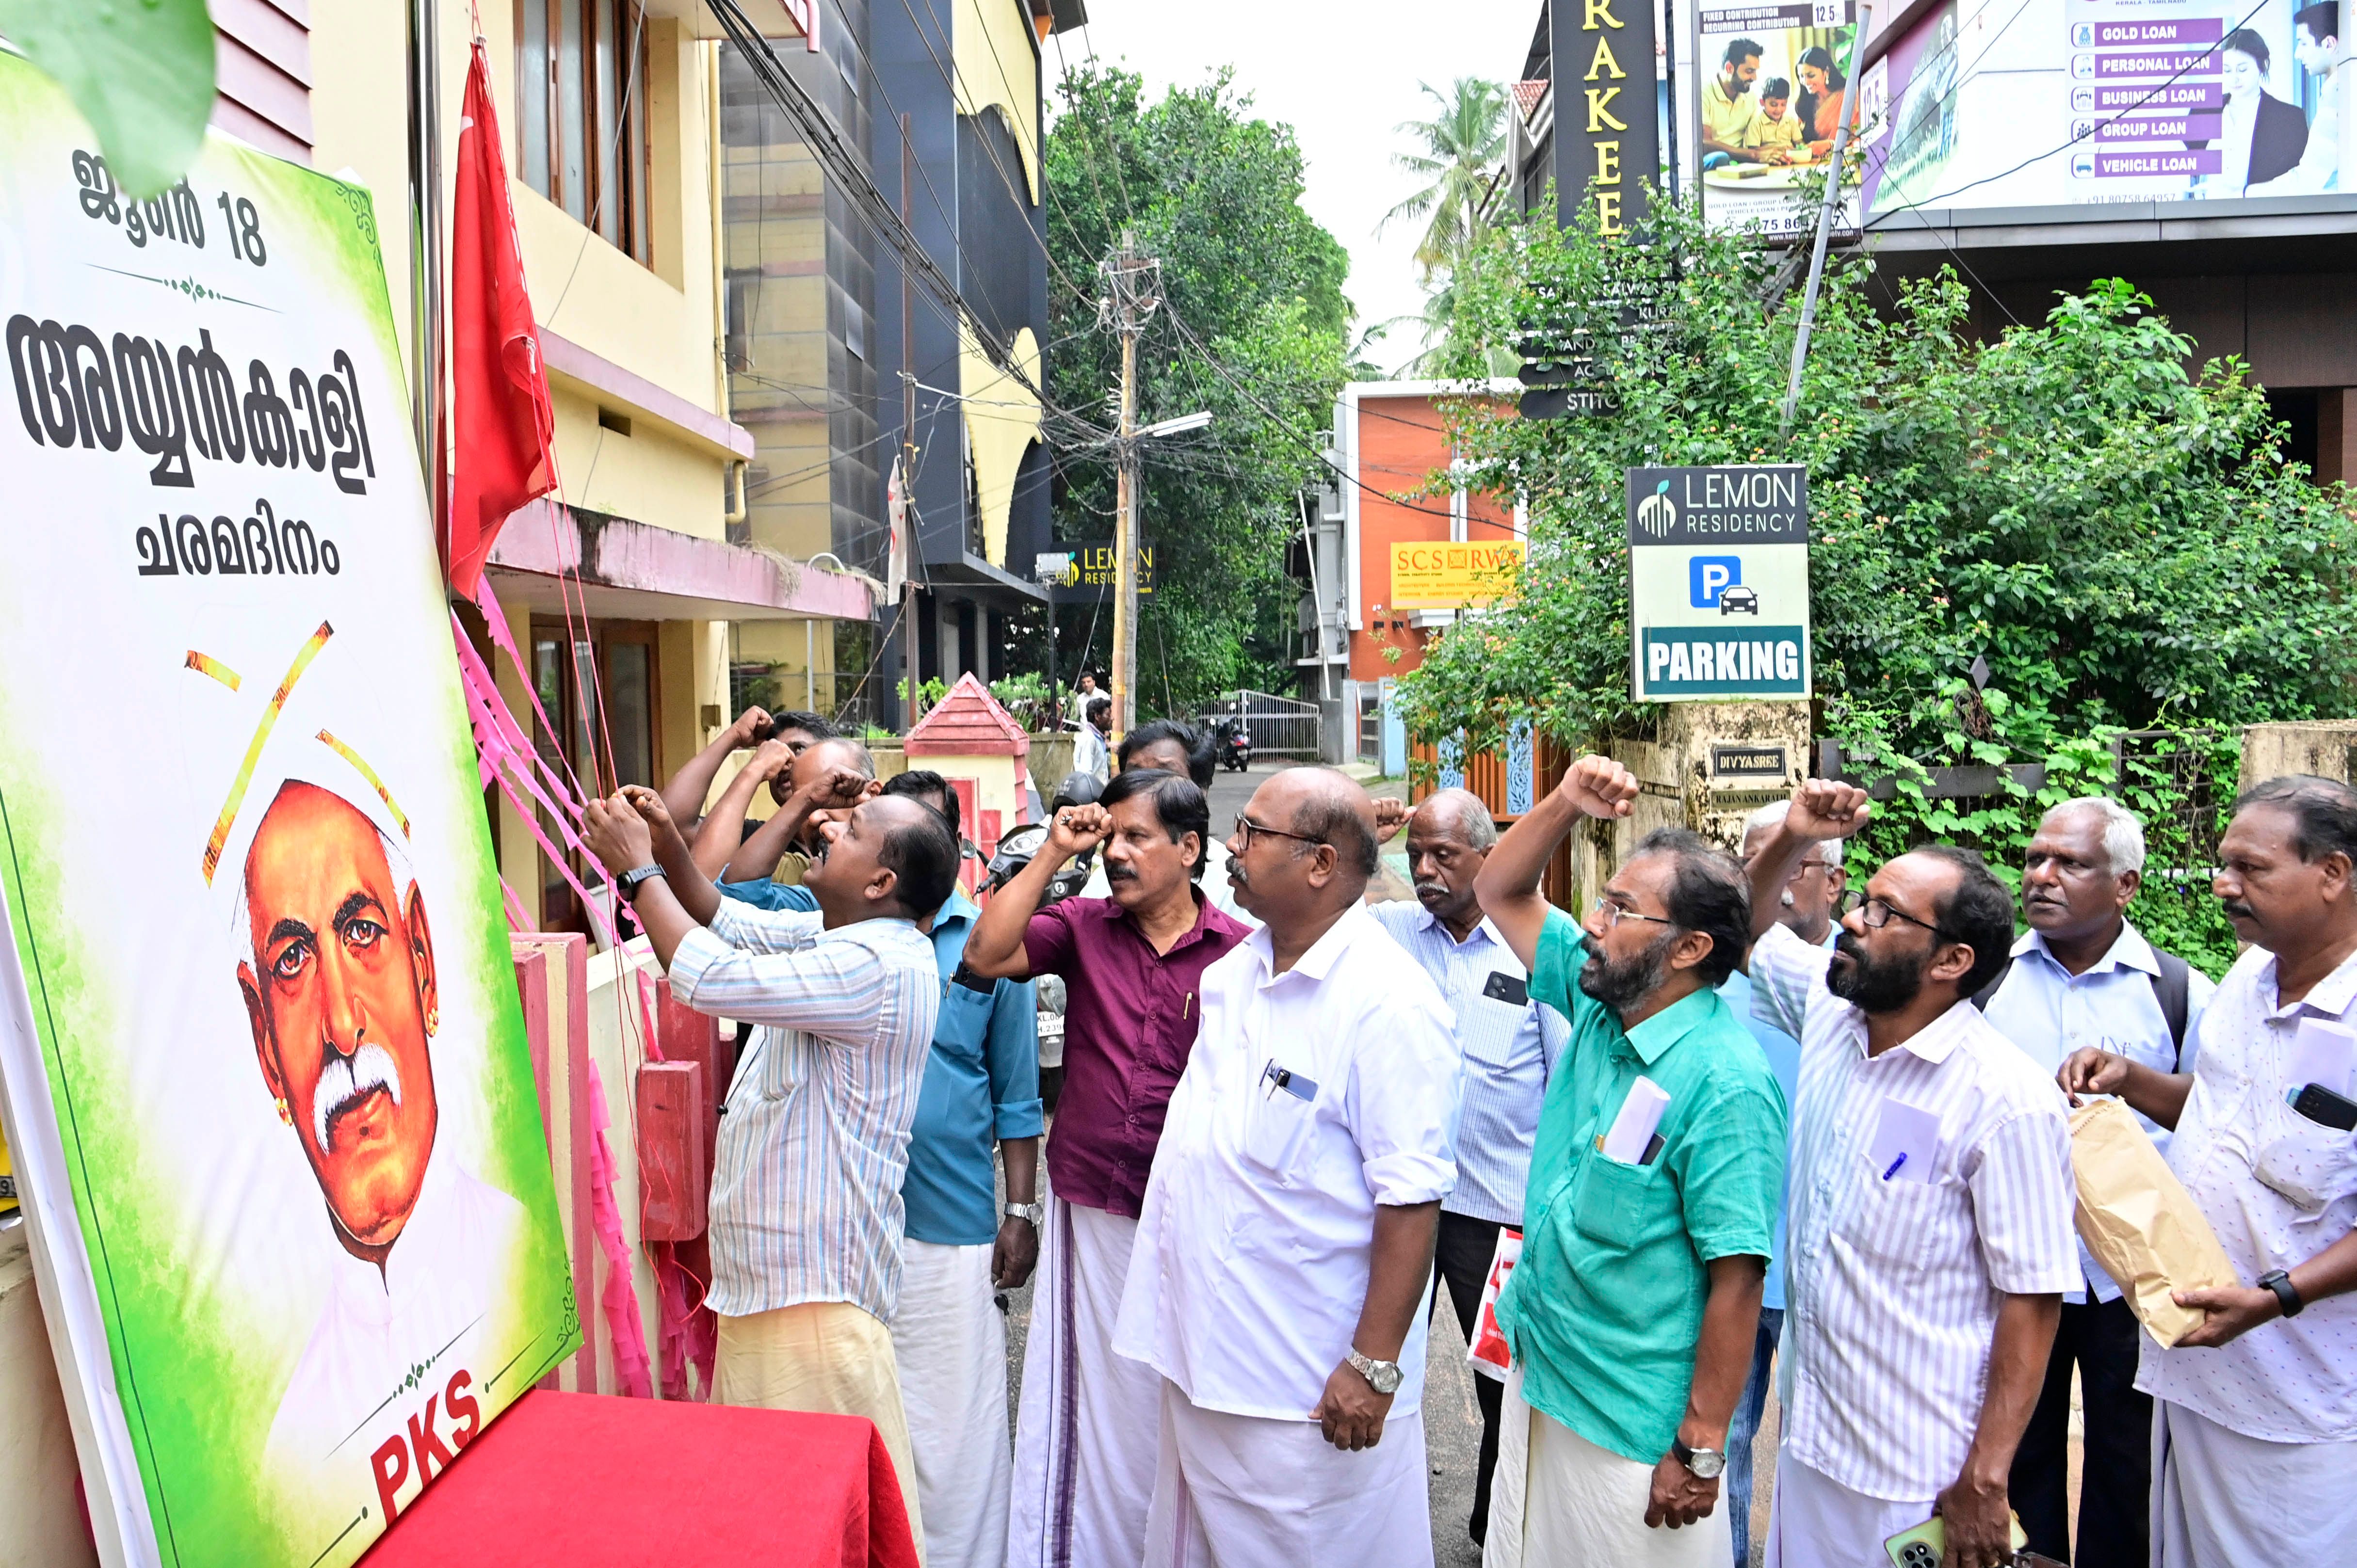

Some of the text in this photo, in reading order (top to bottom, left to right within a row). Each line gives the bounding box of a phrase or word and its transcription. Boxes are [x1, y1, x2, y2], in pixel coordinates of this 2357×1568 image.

[1703, 7, 1778, 22] FIXED CONTRIBUTION
[1703, 16, 1800, 33] RECURRING CONTRIBUTION
[2102, 26, 2177, 40] GOLD LOAN
[2102, 56, 2210, 72] PERSONAL LOAN
[2102, 89, 2205, 105] BUSINESS LOAN
[2102, 122, 2186, 137] GROUP LOAN
[2102, 158, 2196, 172] VEHICLE LOAN
[217, 191, 267, 267] 18
[6, 314, 375, 496] അയ്യൻകാളി
[1686, 473, 1795, 509] LEMON
[1687, 513, 1795, 533] RESIDENCY
[136, 497, 340, 576] ചരമദിനം
[1084, 546, 1152, 570] LEMN
[1085, 571, 1152, 584] RESIDCY
[1649, 640, 1798, 682] PARKING
[1720, 755, 1779, 768] DIVYASREE
[1716, 795, 1743, 803] RAJAN
[371, 1369, 480, 1526] PKS
